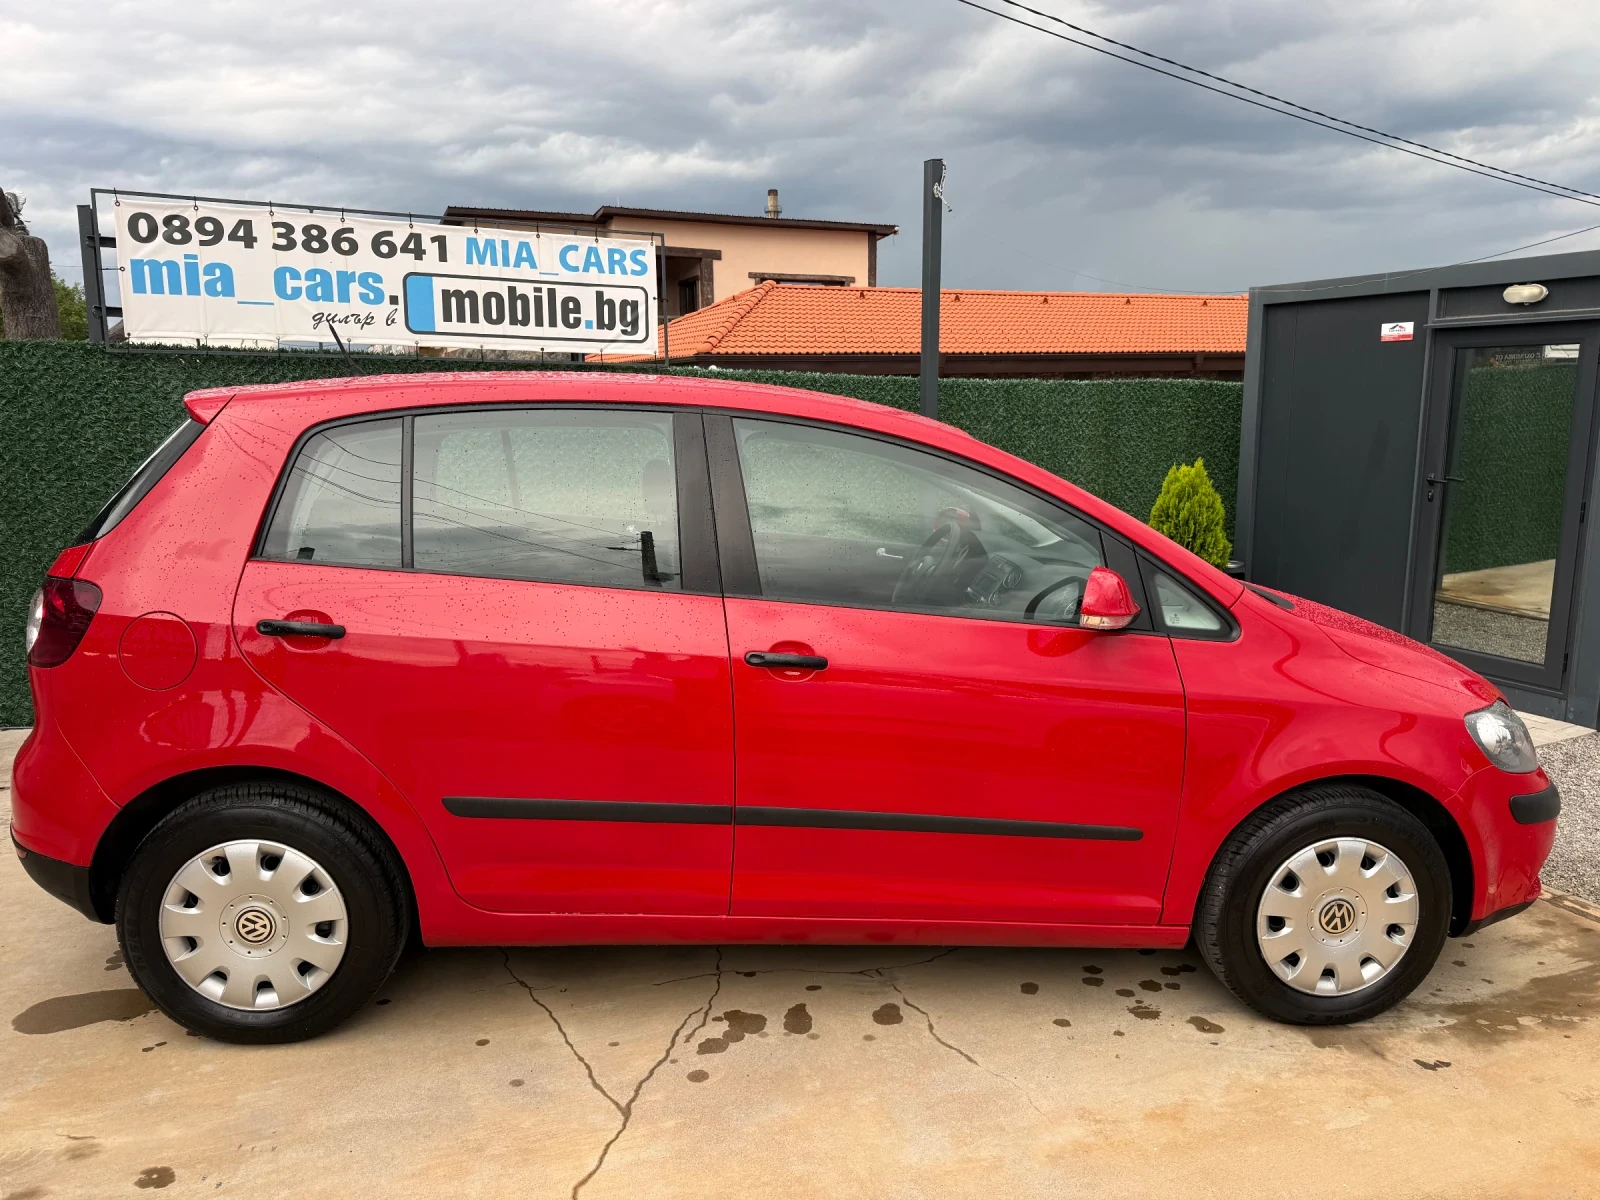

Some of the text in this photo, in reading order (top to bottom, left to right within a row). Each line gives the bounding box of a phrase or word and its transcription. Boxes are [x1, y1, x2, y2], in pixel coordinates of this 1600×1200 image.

[127, 211, 648, 276] 0894 386 641 MIA_CARS
[441, 285, 640, 336] mobile.bg
[236, 909, 273, 943] VW
[1319, 898, 1355, 934] VW
